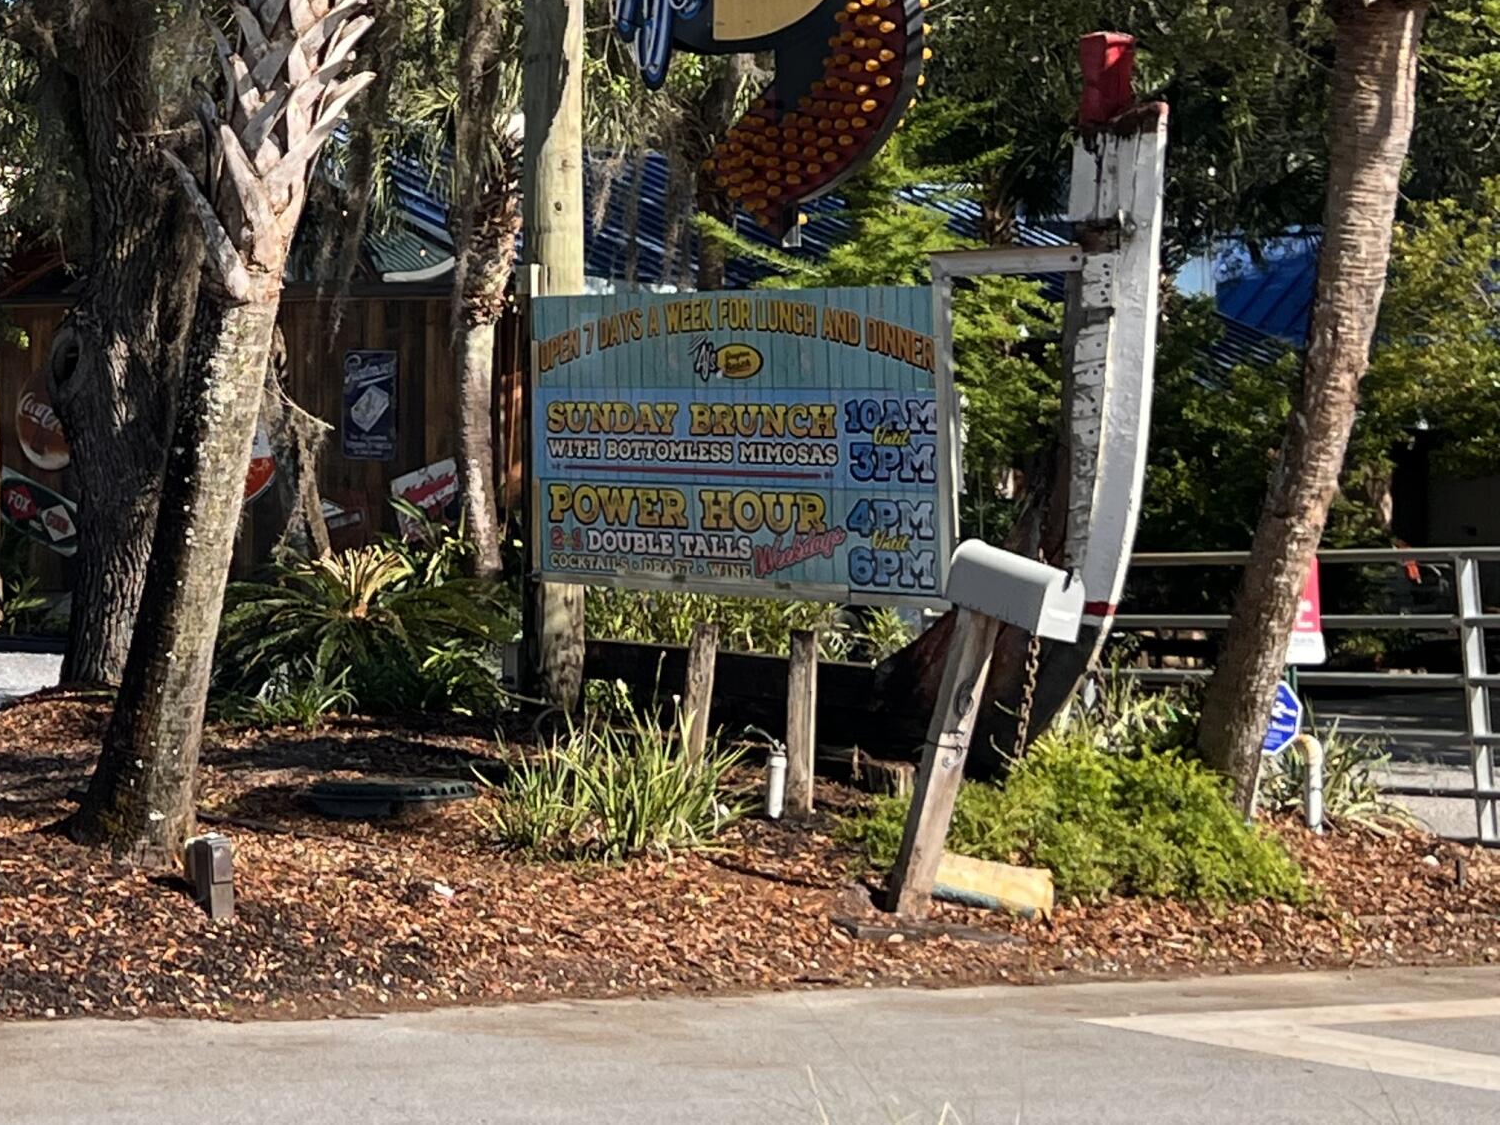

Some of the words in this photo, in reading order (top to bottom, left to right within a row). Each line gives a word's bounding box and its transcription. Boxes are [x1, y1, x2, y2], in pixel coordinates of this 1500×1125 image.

[539, 327, 580, 372] OPEN
[583, 322, 597, 355] 7
[598, 308, 644, 351] DAYS
[647, 305, 661, 338] A
[664, 298, 713, 335] WEEK
[716, 297, 752, 331] FOR
[755, 299, 817, 338] LUNCH
[821, 306, 861, 347] AND
[865, 315, 935, 374] DINNER
[547, 401, 678, 435] SUNDAY
[689, 403, 837, 438] BRUNCH
[844, 398, 936, 435] 10AM
[548, 437, 600, 459] WITH
[605, 439, 733, 463] BOTTOMLESS
[738, 442, 839, 466] MIMOSAS
[871, 424, 911, 447] Until
[850, 442, 936, 483] 3PM
[7, 488, 32, 513] FOX
[548, 483, 688, 528] POWER
[700, 489, 827, 535] HOUR
[846, 499, 935, 541] 4PM
[587, 528, 674, 557] DOUBLE
[679, 531, 752, 560] TALLS
[754, 525, 848, 579] Weekdays
[871, 527, 911, 552] Until
[550, 553, 630, 573] COCKTAILS
[642, 558, 694, 575] DRAFT
[707, 562, 752, 578] WINE
[849, 546, 936, 589] 6PM
